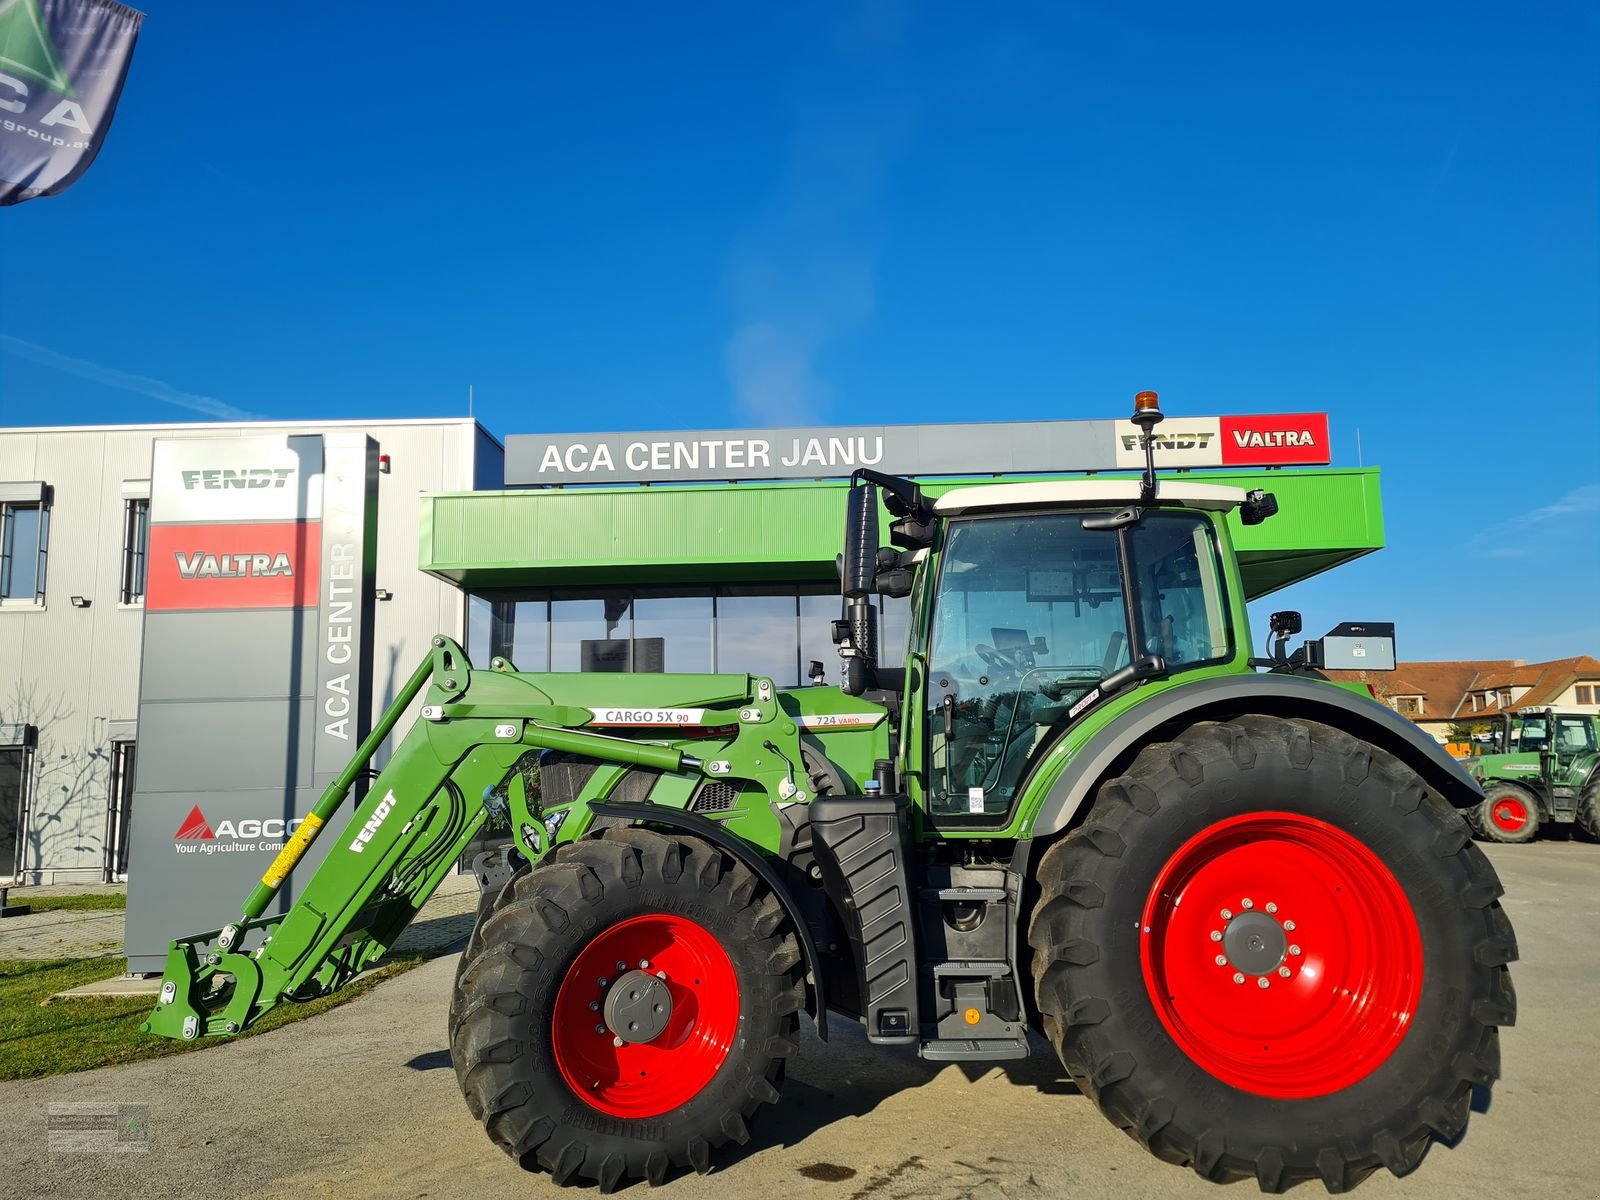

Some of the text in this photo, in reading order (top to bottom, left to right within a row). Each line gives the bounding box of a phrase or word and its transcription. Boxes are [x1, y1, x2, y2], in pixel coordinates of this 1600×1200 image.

[1232, 429, 1316, 449] VALTRA
[538, 436, 883, 472] ACA CENTER JANU
[181, 469, 295, 490] FENDT
[174, 551, 294, 579] VALTRA
[324, 543, 355, 741] ACA CENTER
[605, 711, 689, 722] CARGO 5X 90
[816, 716, 836, 725] 724
[349, 788, 398, 853] FENDT
[175, 843, 198, 853] Your
[199, 841, 256, 855] Agriculture
